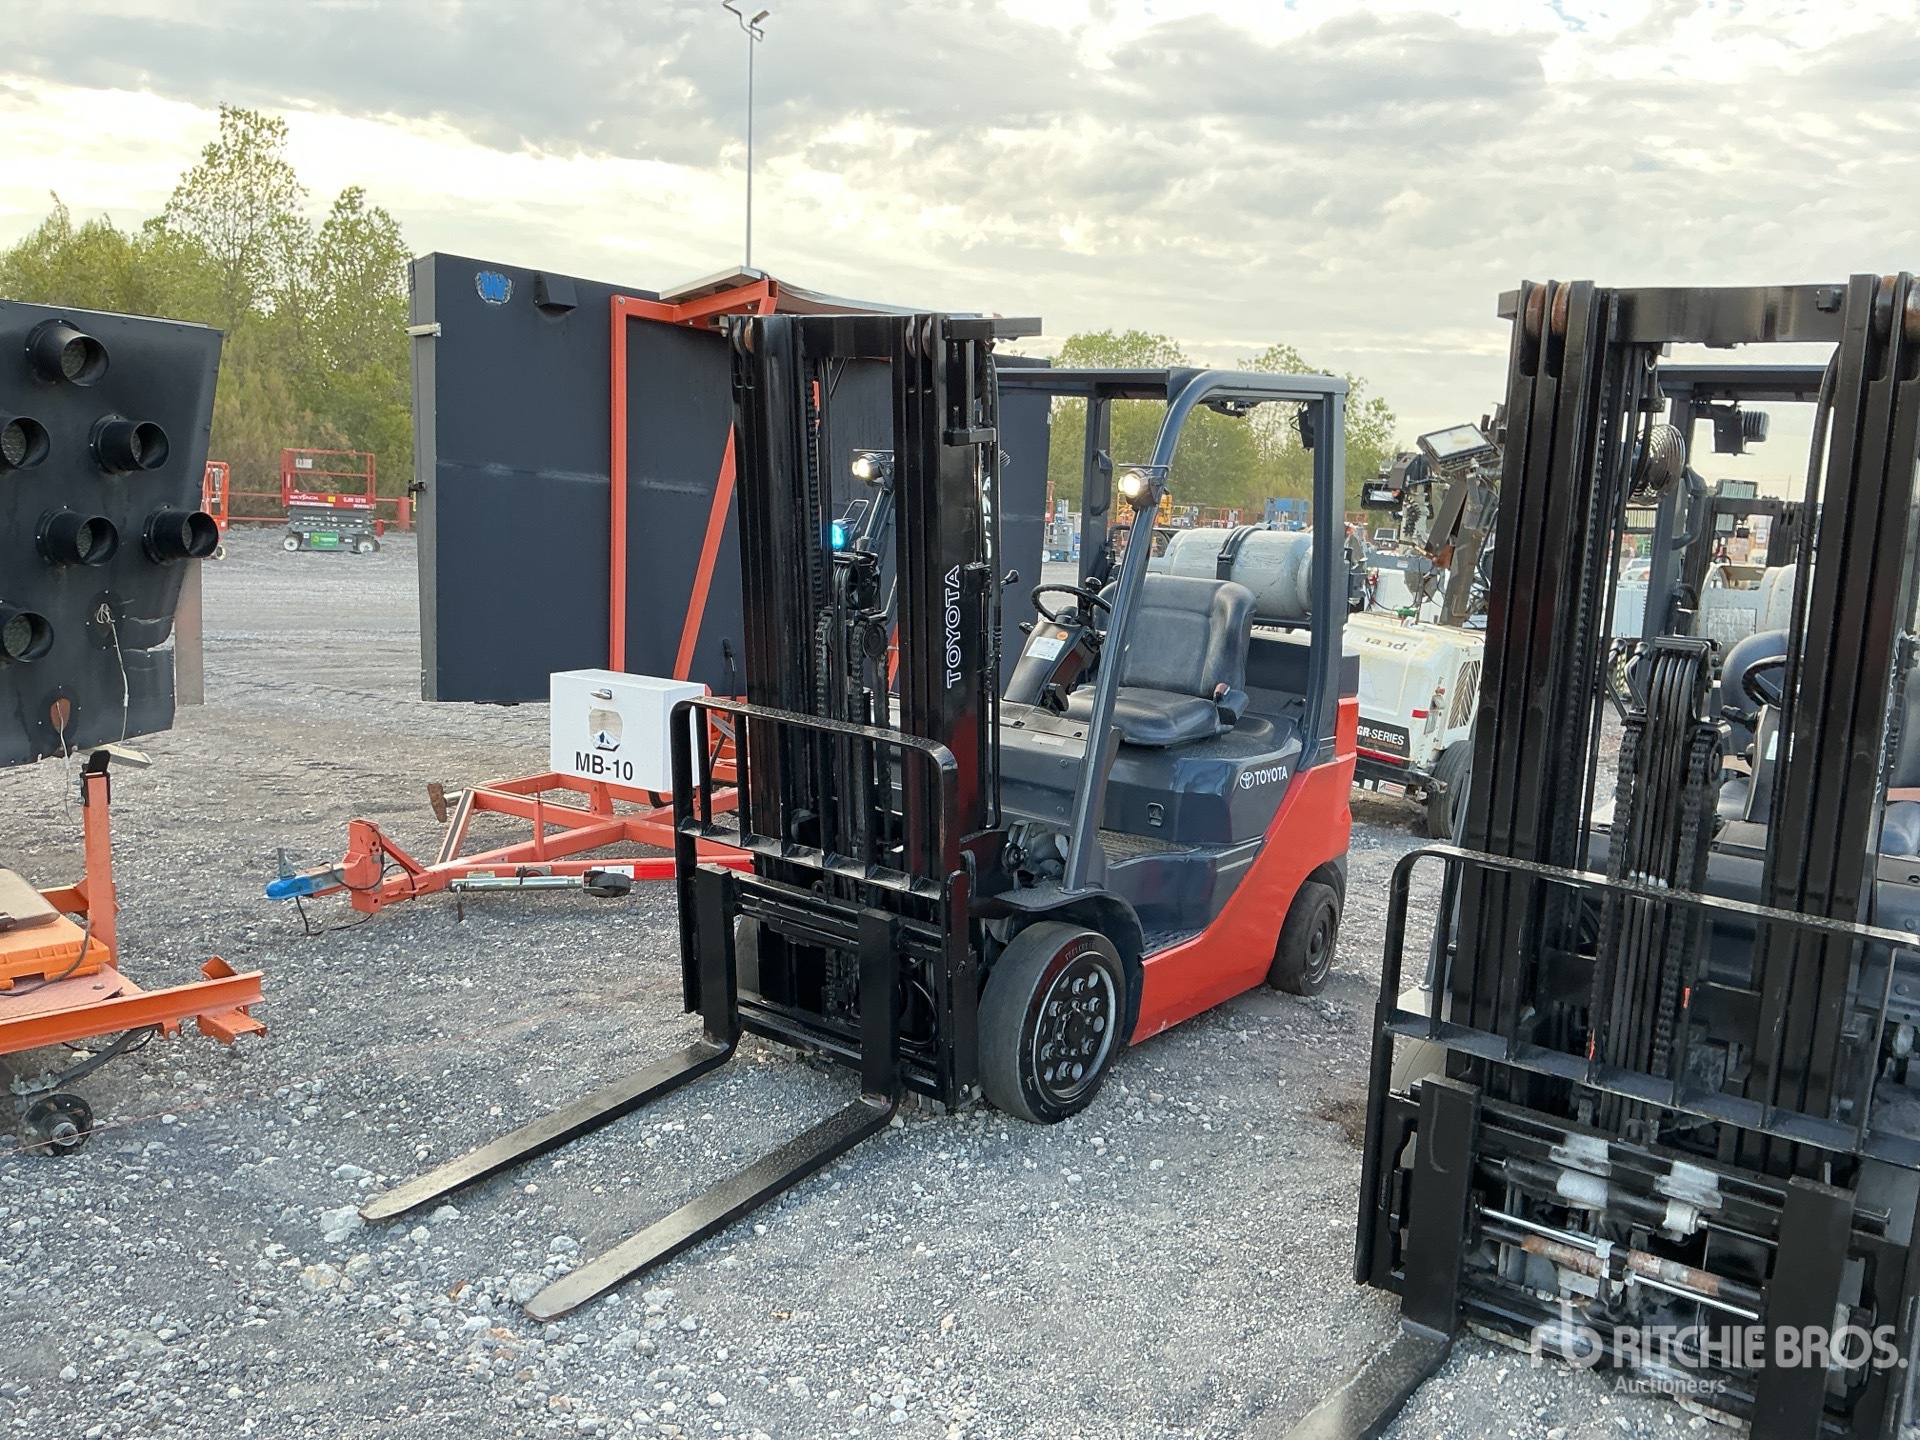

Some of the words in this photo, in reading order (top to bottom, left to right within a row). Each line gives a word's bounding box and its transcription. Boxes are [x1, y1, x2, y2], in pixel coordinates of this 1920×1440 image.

[945, 564, 962, 689] TOYOTA
[575, 751, 633, 781] MB-10
[1254, 765, 1288, 786] TOYOTA
